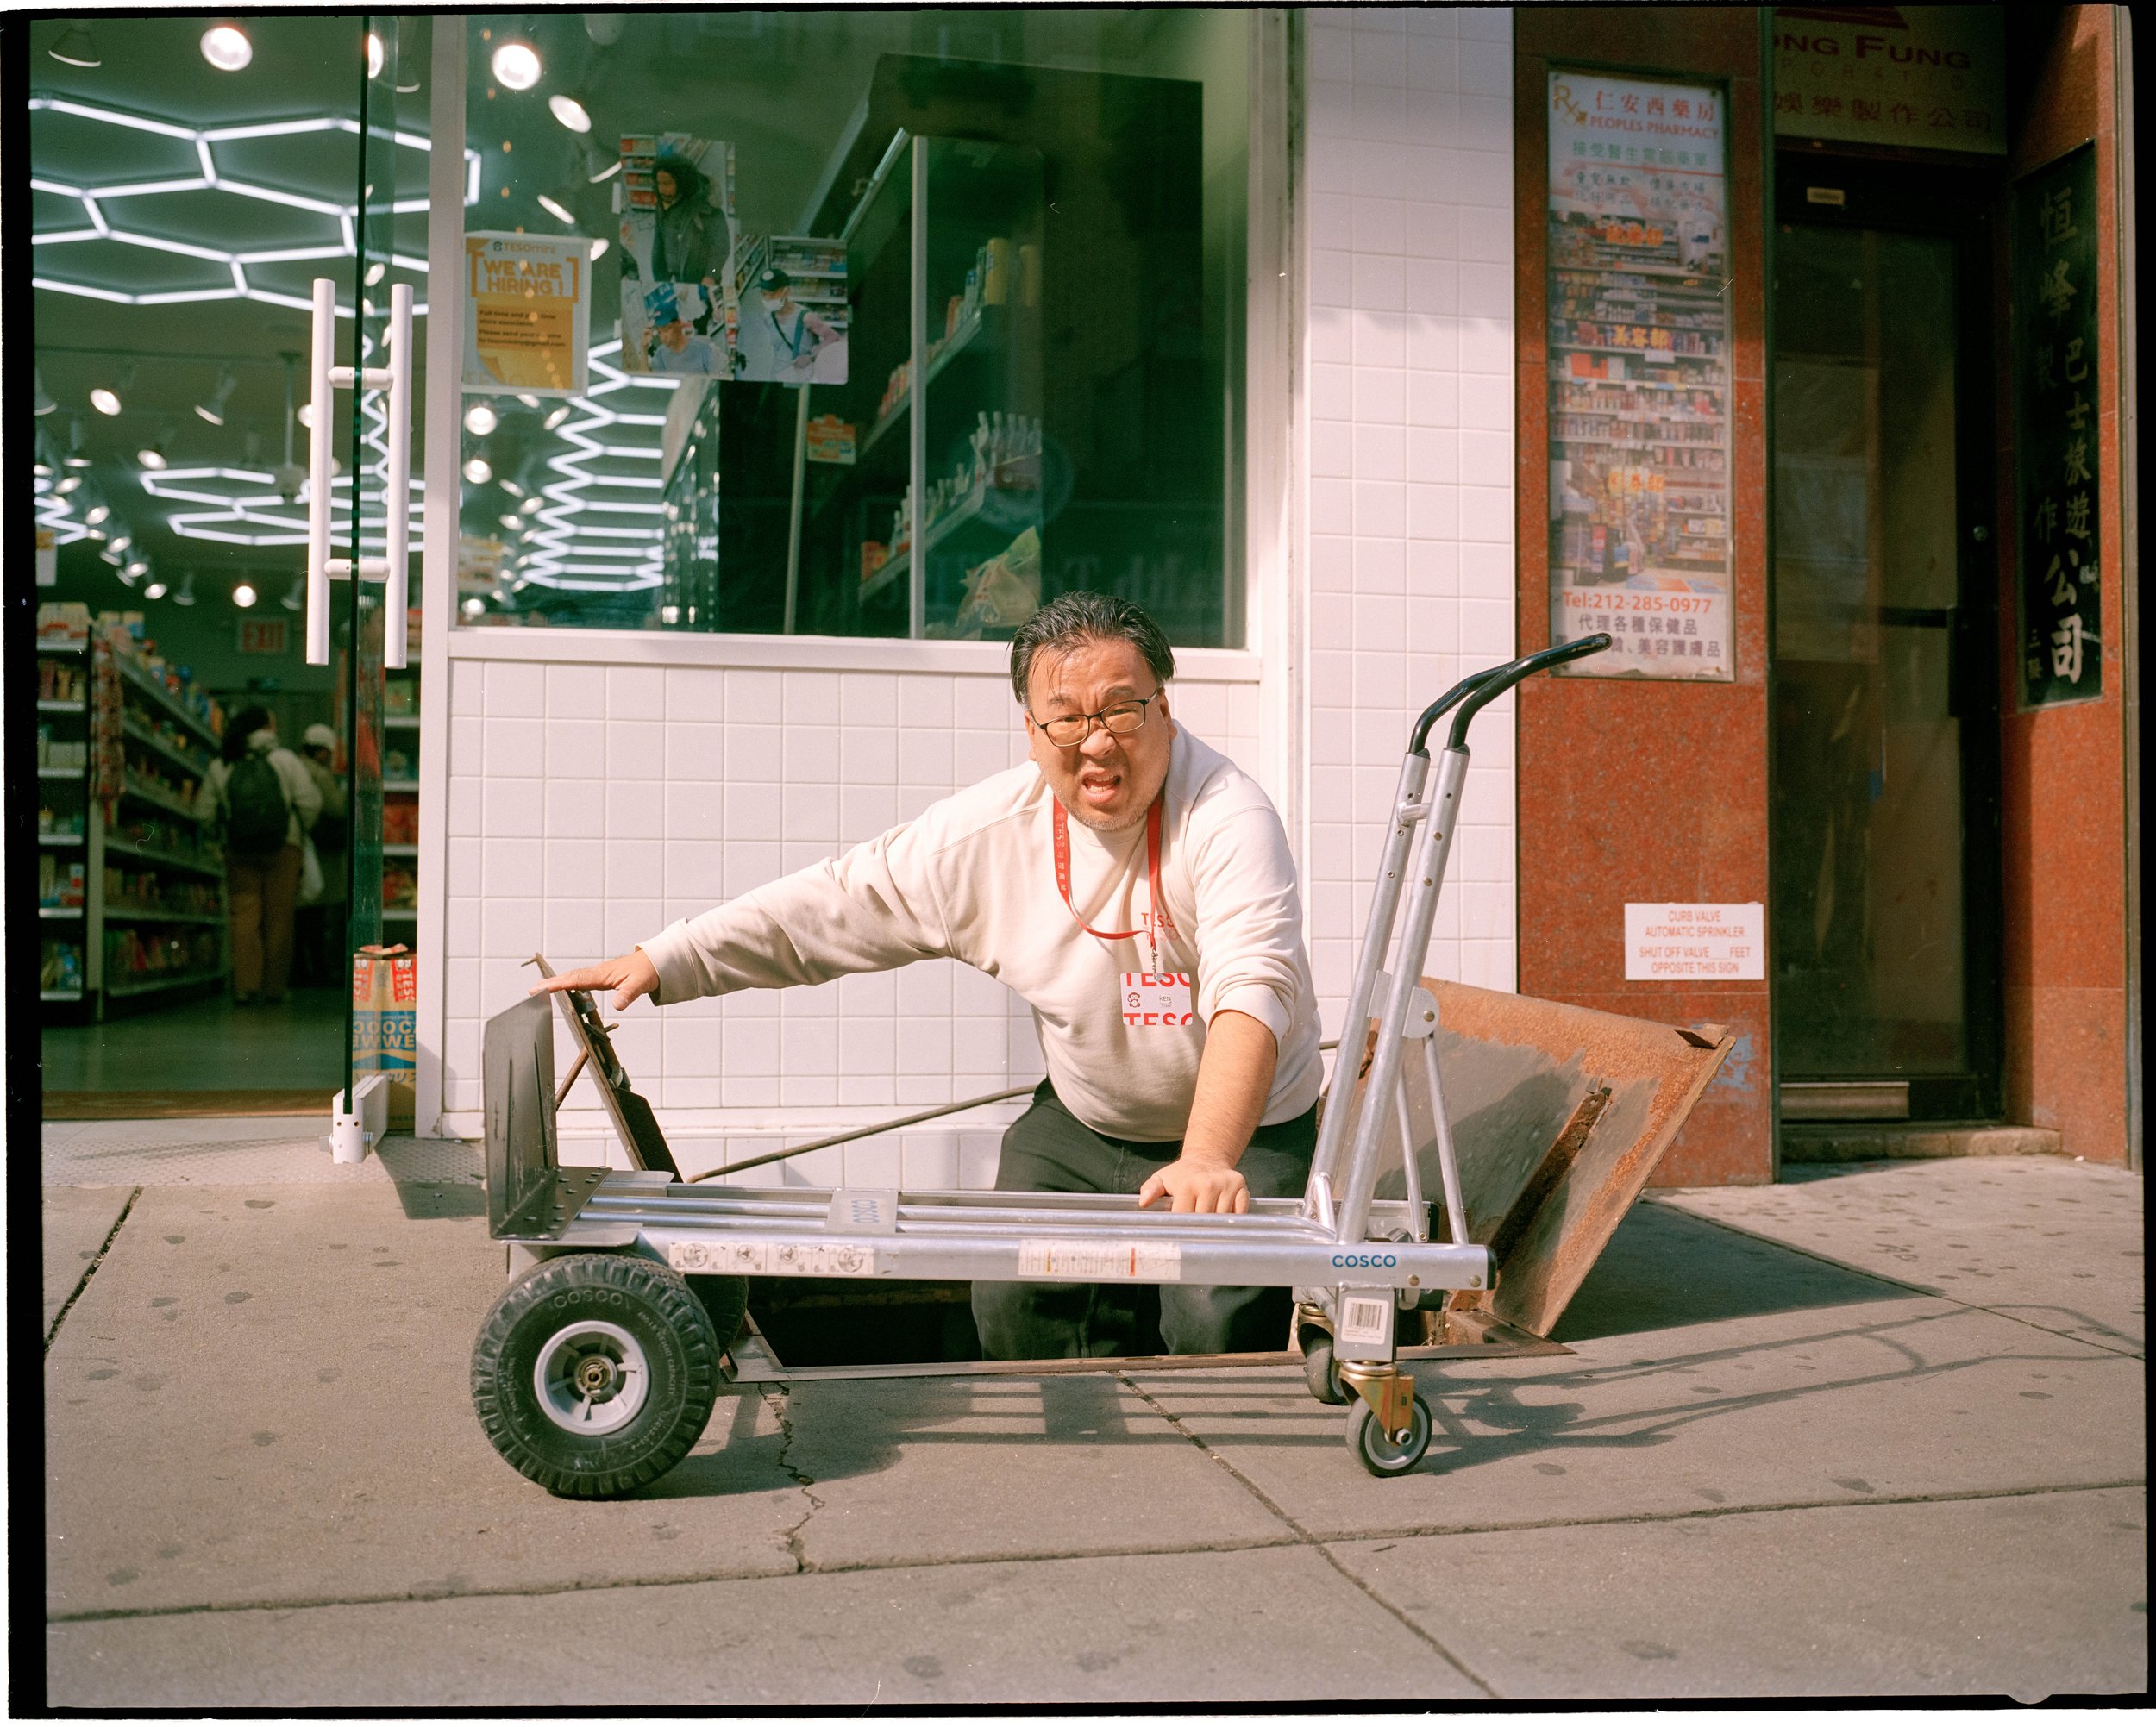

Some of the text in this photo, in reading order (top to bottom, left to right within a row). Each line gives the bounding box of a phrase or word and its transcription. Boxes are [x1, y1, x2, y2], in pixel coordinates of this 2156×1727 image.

[1855, 35, 1971, 69] FUNG
[1595, 90, 1716, 122] 仁安西藥房
[1590, 115, 1718, 139] PEOPLES PHARMACY
[483, 260, 561, 279] WE ARE
[1563, 591, 1712, 614] Tel:212-285-0977
[1578, 614, 1698, 635] 代理各種保健品
[242, 619, 285, 652] EXIT
[1141, 911, 1176, 929] TSO
[1669, 910, 1721, 923] CURB VALVE
[1645, 926, 1745, 938] AUTOMATIC SPRINKLER
[1639, 946, 1751, 958] SHUT OFF VALVE FEET
[1651, 962, 1739, 973] OPPOSITE THIS SIGN
[1332, 1255, 1397, 1268] COSCO
[554, 1289, 624, 1309] COSCO
[666, 1357, 676, 1395] CAPACITY
